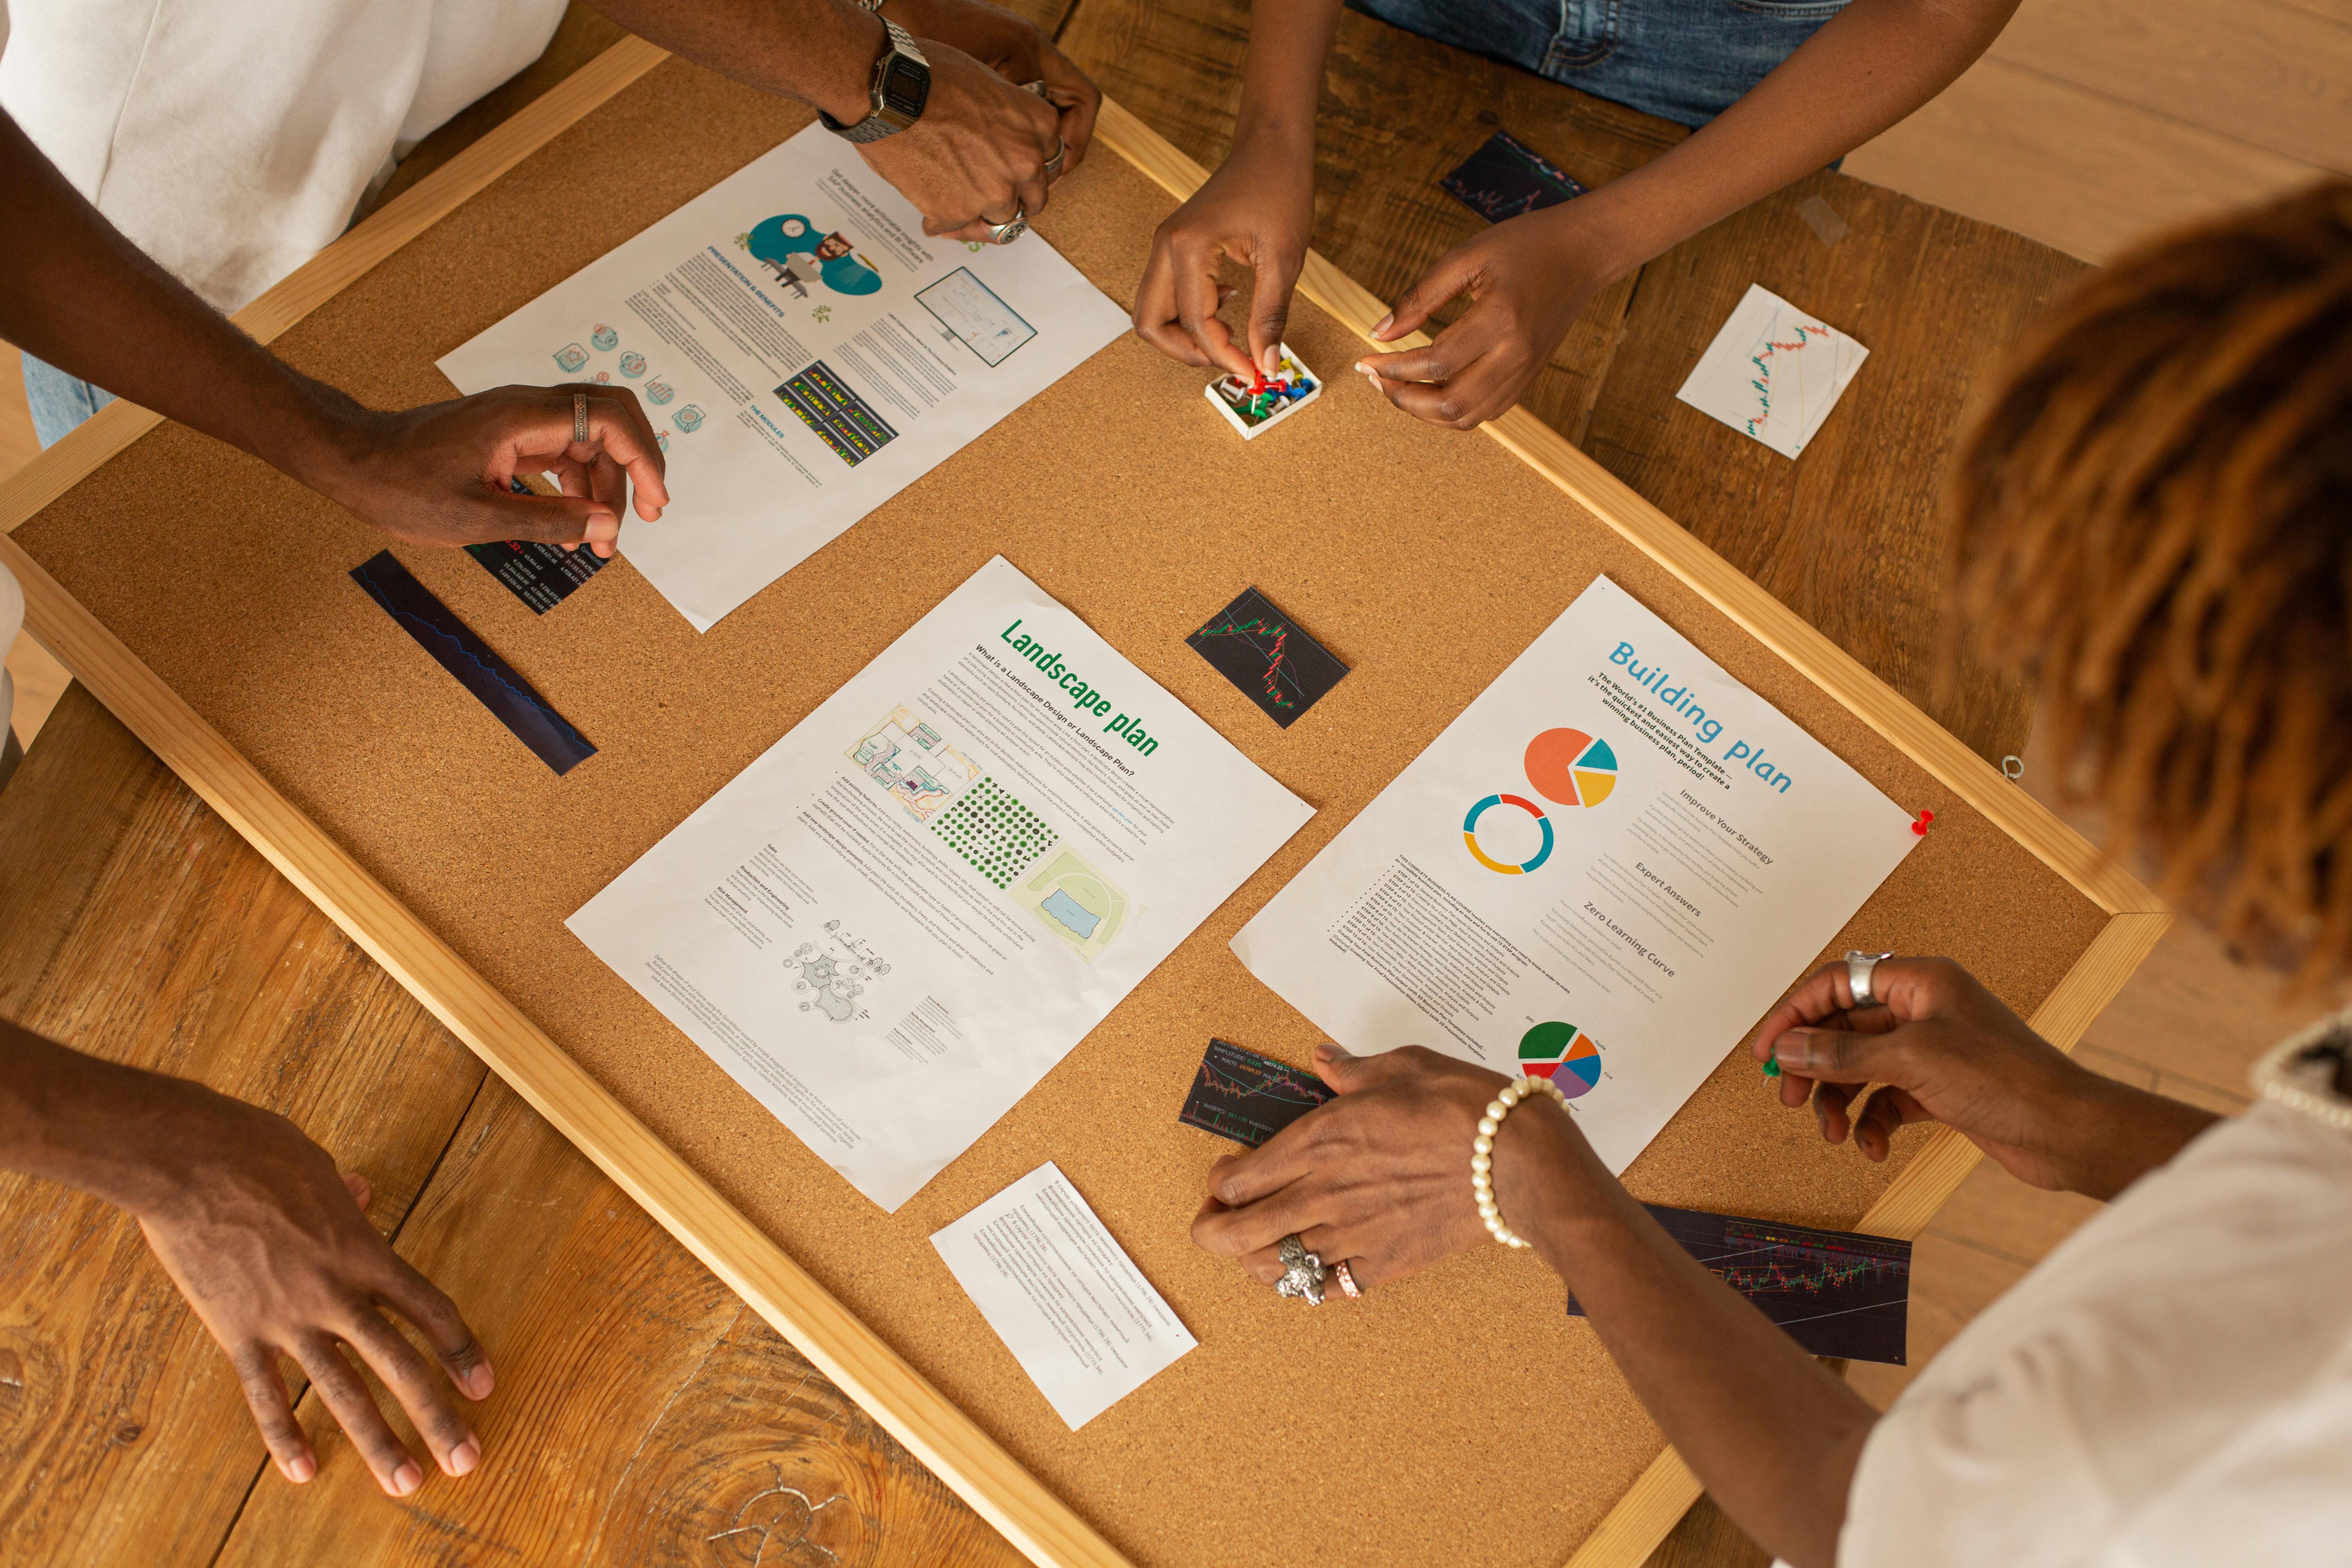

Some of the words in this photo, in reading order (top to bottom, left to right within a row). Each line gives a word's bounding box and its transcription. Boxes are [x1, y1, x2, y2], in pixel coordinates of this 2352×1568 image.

[707, 246, 752, 286] PRESENTATION
[755, 290, 784, 317] BENEFITS
[750, 405, 761, 415] THE
[759, 414, 784, 438] MODULES
[917, 697, 936, 714] constraints.
[976, 644, 995, 662] What
[1006, 670, 1043, 702] Landscape
[1043, 701, 1067, 722] Design
[1076, 728, 1113, 760] Landscape
[1113, 758, 1134, 776] Plan?
[1000, 619, 1111, 717] Landscape
[1102, 713, 1158, 756] plan
[1598, 672, 1611, 684] The
[1637, 704, 1647, 712] #1
[1647, 710, 1677, 736] Business
[1677, 734, 1693, 749] Plan
[1694, 747, 1725, 774] Template
[1600, 685, 1612, 696] the
[1612, 695, 1641, 719] quickest
[1641, 718, 1656, 730] and
[1655, 729, 1679, 749] easiest
[1679, 748, 1694, 761] way
[1703, 767, 1724, 785] create
[1602, 698, 1630, 723] winning
[1630, 719, 1659, 745] business
[1659, 744, 1676, 760] plan,
[1677, 759, 1704, 780] period!
[1609, 641, 1723, 743] Building
[1723, 740, 1791, 793] plan
[849, 783, 863, 795] existing
[862, 794, 877, 808] features.
[1112, 807, 1125, 818] garden
[818, 798, 830, 809] Create
[829, 808, 843, 820] ground
[842, 820, 853, 829] cover
[855, 831, 869, 844] needed.
[1680, 789, 1715, 820] Improve
[1717, 817, 1737, 835] Your
[1736, 834, 1773, 864] Strategy
[767, 844, 777, 853] Sales
[817, 823, 835, 840] landscape
[835, 839, 847, 850] design
[846, 849, 863, 865] elements.
[717, 886, 725, 894] Risk
[725, 893, 748, 913] Management
[739, 865, 760, 884] Production
[766, 889, 789, 910] Engineering
[1635, 862, 1664, 887] Expert
[1663, 886, 1701, 916] Answers
[1399, 854, 1408, 862] THIS
[1408, 862, 1428, 878] COMPLETE
[1427, 878, 1446, 893] BUSINESS
[1446, 892, 1456, 901] PLAN
[1456, 900, 1472, 913] COURSE
[1471, 913, 1485, 925] teaches
[1492, 930, 1511, 946] everything
[1518, 951, 1528, 959] need
[1531, 962, 1541, 970] know
[1545, 973, 1555, 982] order
[1559, 985, 1570, 993] make
[1420, 888, 1434, 900] General
[1433, 898, 1448, 911] Business
[1455, 917, 1466, 927] Inputs
[1466, 926, 1483, 940] Questions
[1490, 944, 1504, 957] Analysis
[1584, 901, 1605, 921] Zero
[1606, 919, 1647, 956] Learning
[1647, 953, 1674, 977] Curve
[1329, 938, 1346, 953] included)
[911, 1012, 919, 1020] Facility
[919, 1019, 935, 1033] Management
[927, 996, 936, 1004] Human
[936, 1003, 949, 1014] Resources
[901, 1035, 912, 1045] Managers
[1595, 1040, 1606, 1050] Toyota
[1567, 1102, 1579, 1111] Jaguar
